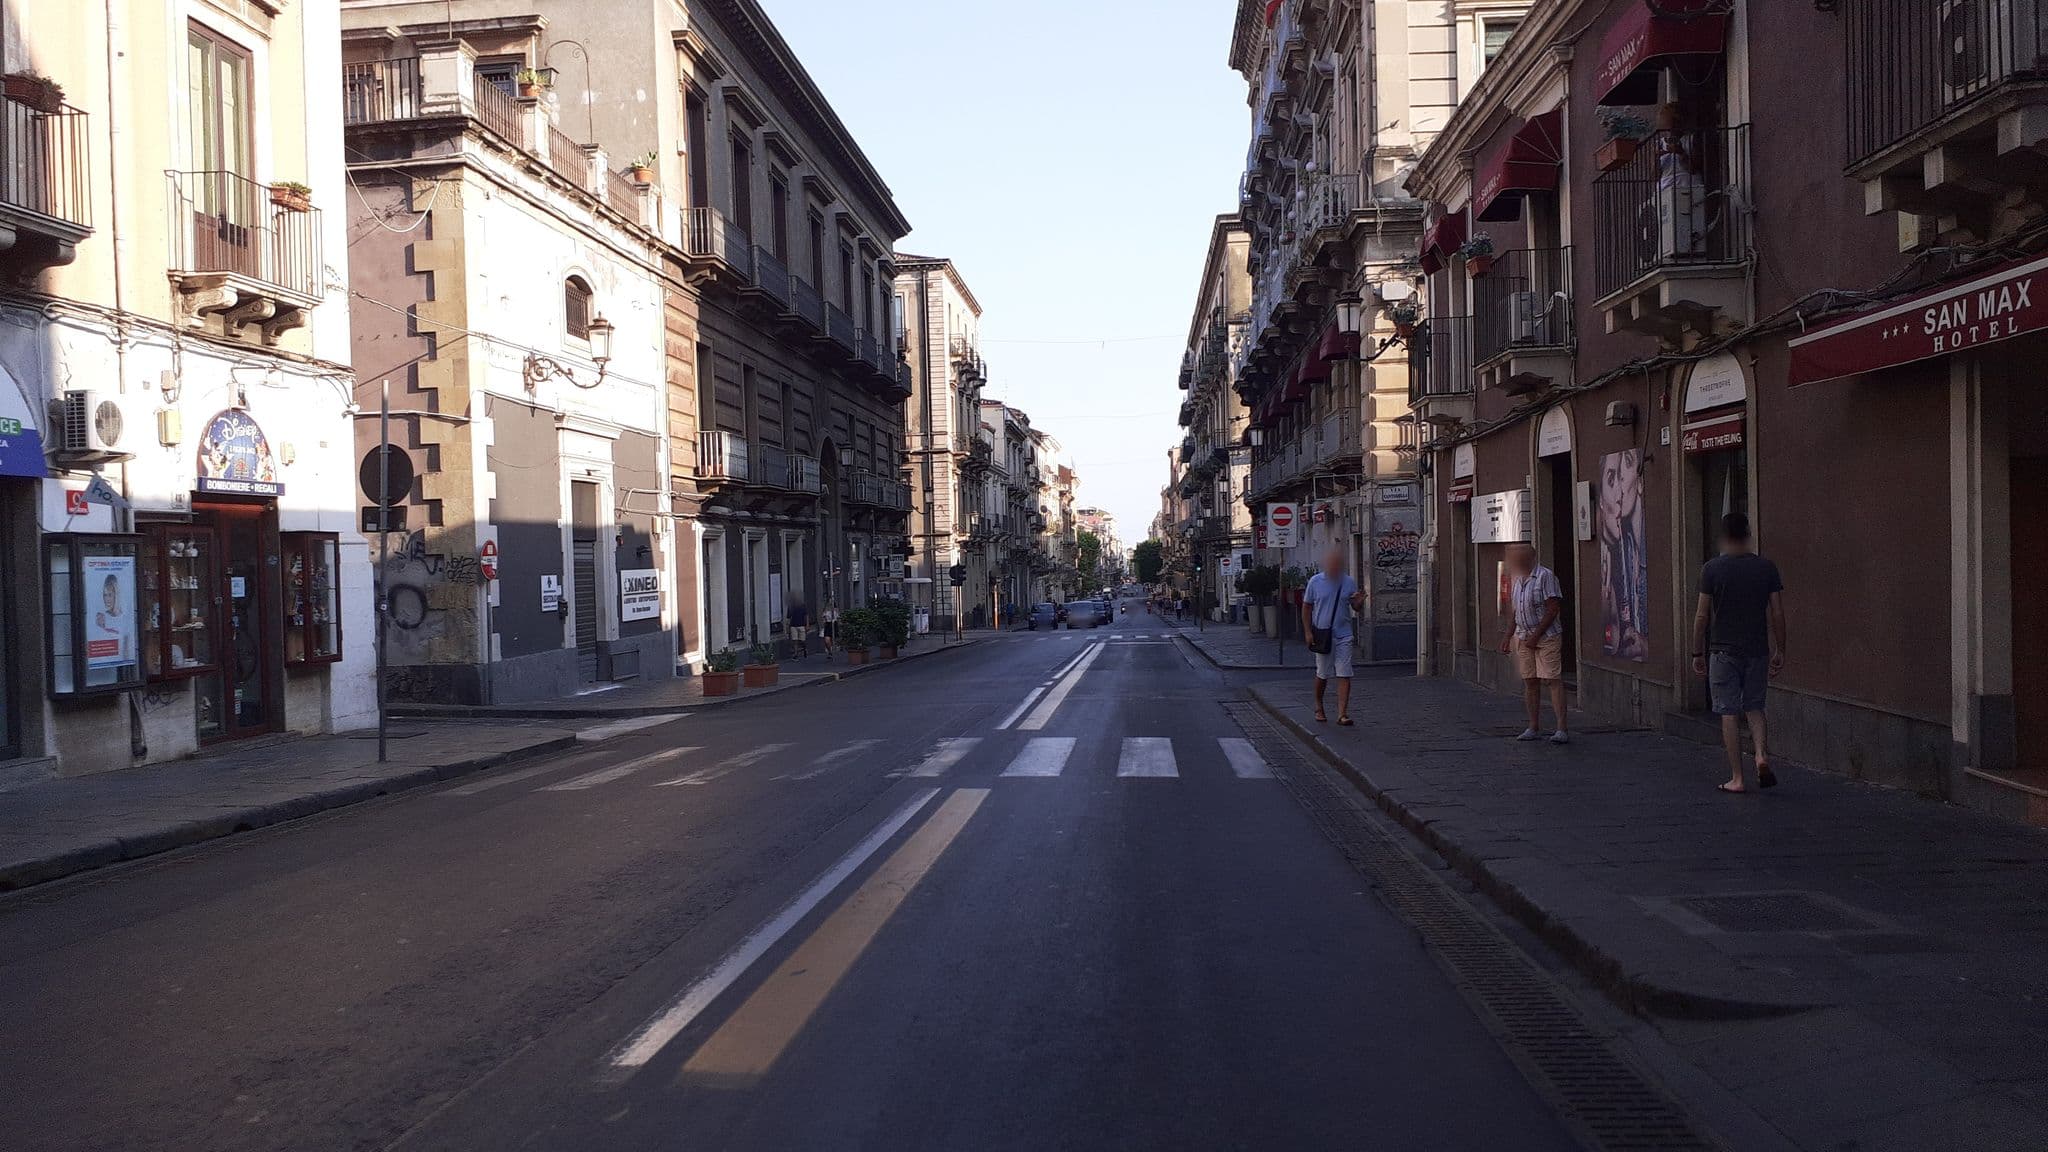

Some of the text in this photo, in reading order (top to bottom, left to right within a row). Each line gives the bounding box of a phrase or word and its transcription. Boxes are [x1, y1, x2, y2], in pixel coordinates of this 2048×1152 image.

[1923, 278, 2033, 335] SAN MAX
[1933, 316, 2019, 353] HOTEL
[207, 480, 277, 493] BOMBONIERE REGALI
